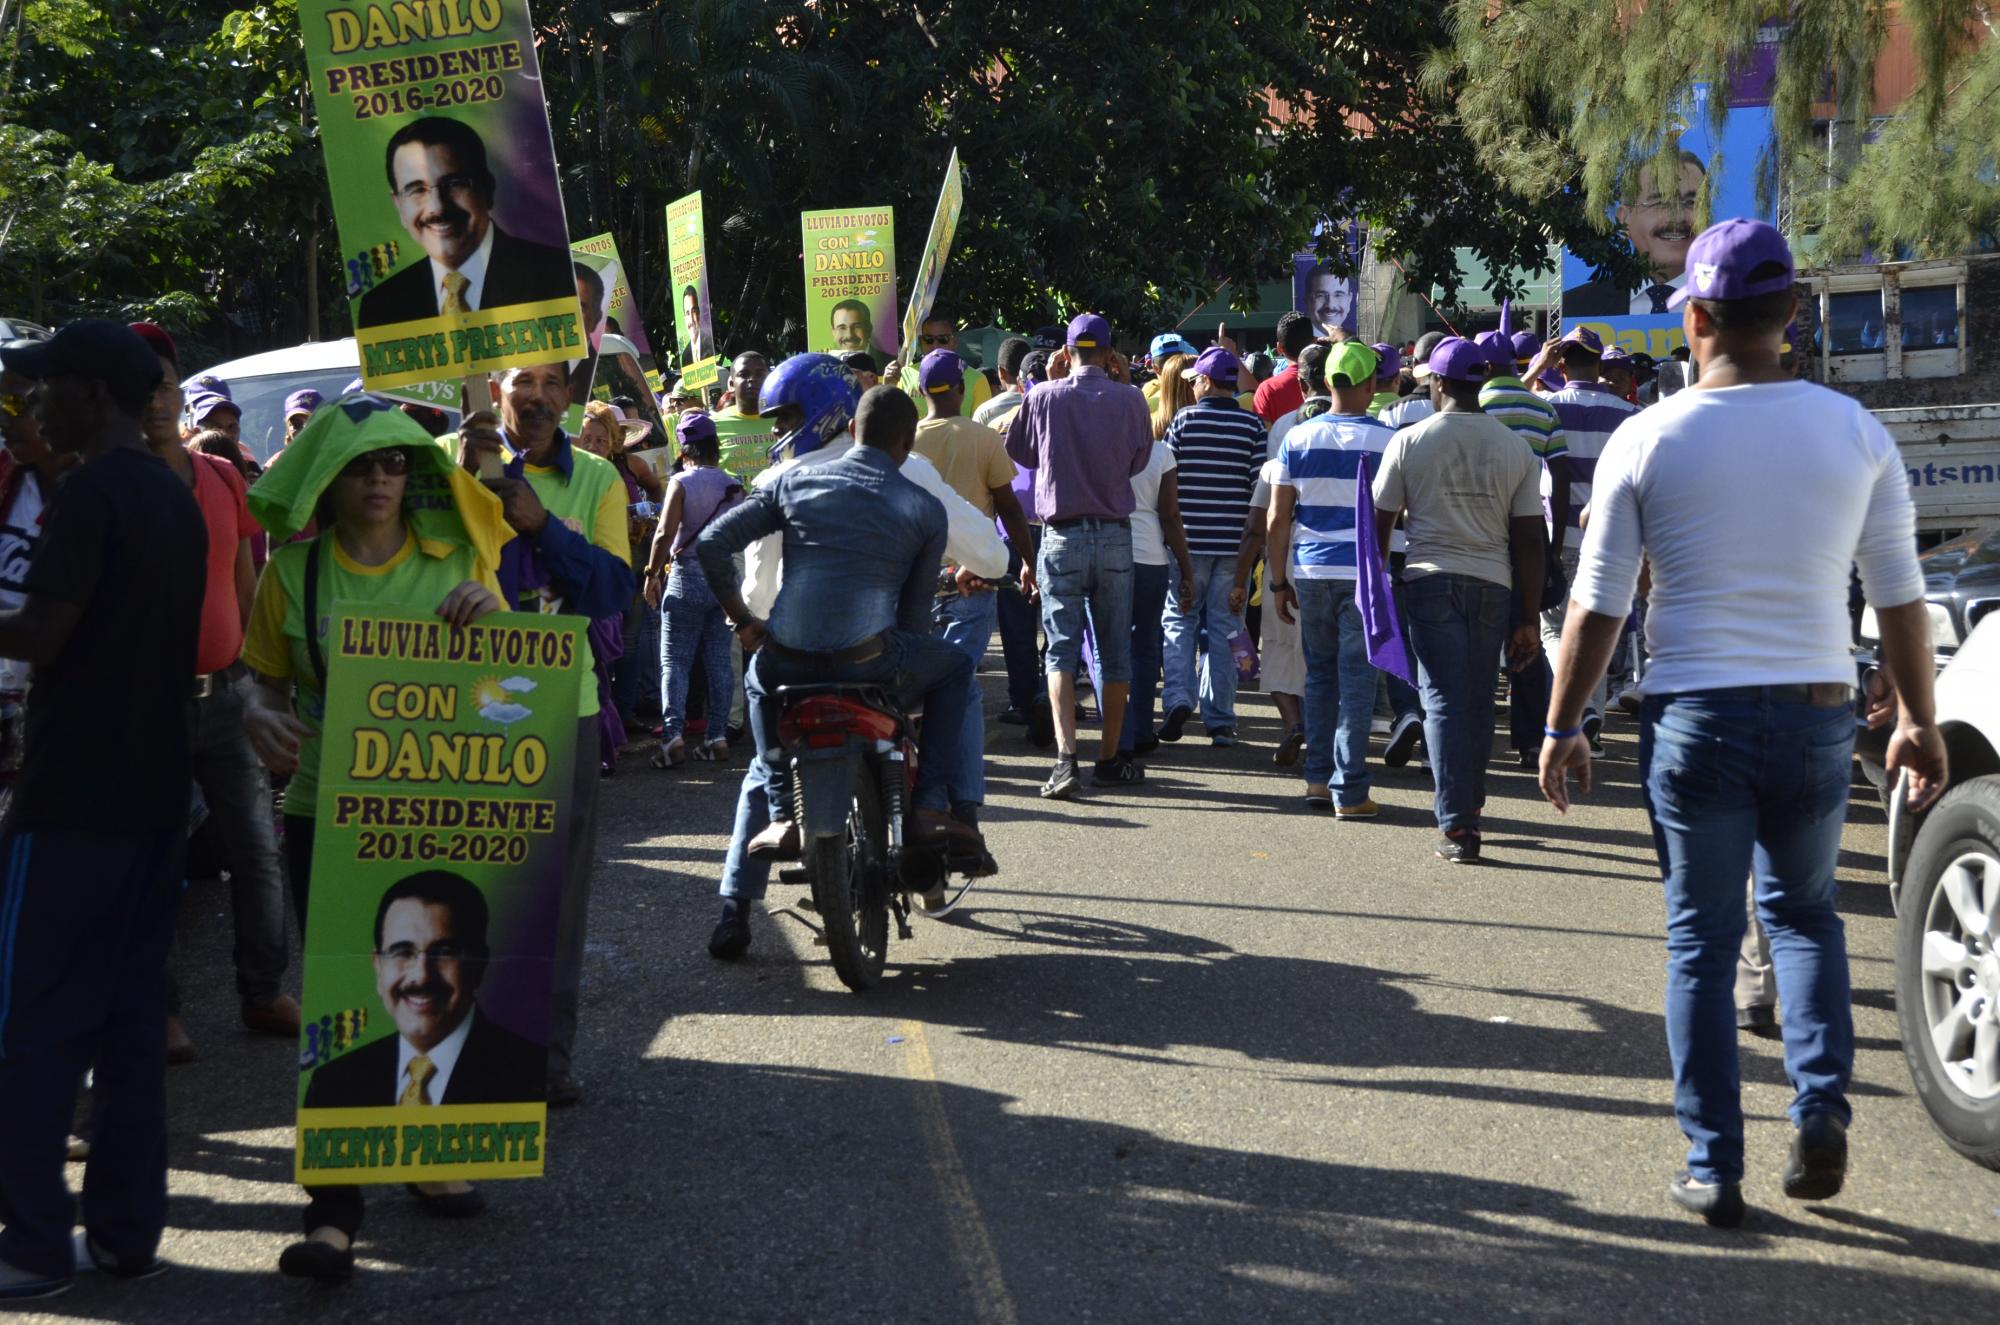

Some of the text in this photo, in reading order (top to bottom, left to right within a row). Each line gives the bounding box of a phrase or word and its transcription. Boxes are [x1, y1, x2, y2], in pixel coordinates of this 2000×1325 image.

[326, 0, 502, 54] DANILO
[326, 42, 522, 95] PRESIDENTE
[353, 76, 504, 119] 2016-2020
[807, 213, 889, 230] LLUVIA DE VOTOS
[815, 250, 885, 272] DANILO
[818, 236, 849, 250] CON
[812, 272, 889, 287] PRESIDENTE
[821, 285, 881, 298] 2016-2020
[363, 312, 580, 377] MERYS PRESENTE
[1904, 462, 2000, 487] htsm
[342, 618, 441, 662] LLUVIA
[447, 624, 484, 663] DE
[488, 628, 575, 669] VOTOS
[368, 681, 457, 721] CON
[350, 728, 548, 787] DANILO
[335, 794, 555, 832] PRESIDENTE
[357, 831, 528, 864] 2016-2020
[302, 1121, 541, 1170] MERYS PRESENTE
